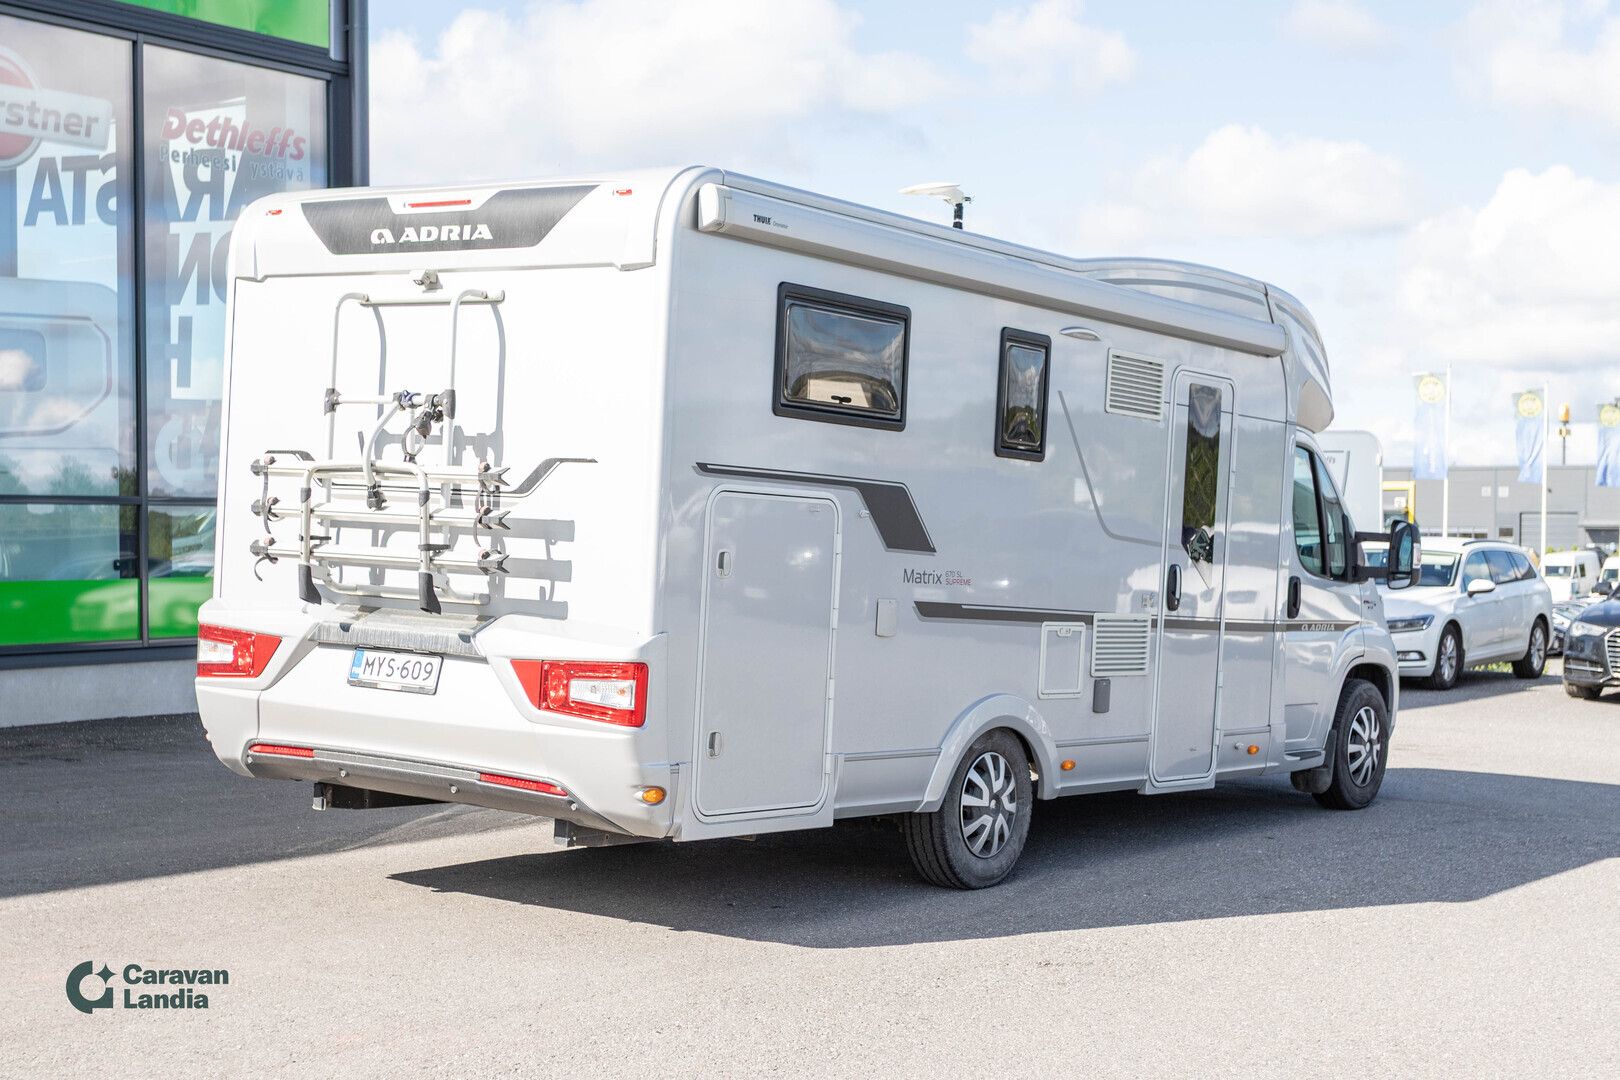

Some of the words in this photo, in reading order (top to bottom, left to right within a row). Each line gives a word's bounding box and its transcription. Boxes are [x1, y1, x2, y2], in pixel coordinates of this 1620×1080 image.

[160, 107, 306, 161] Dethleffs
[160, 143, 237, 172] Perheesi
[753, 214, 772, 226] THULE
[399, 224, 494, 243] ADRIA
[903, 568, 942, 585] Matrix
[1310, 624, 1335, 632] ADRIA
[362, 656, 434, 681] MYS-609
